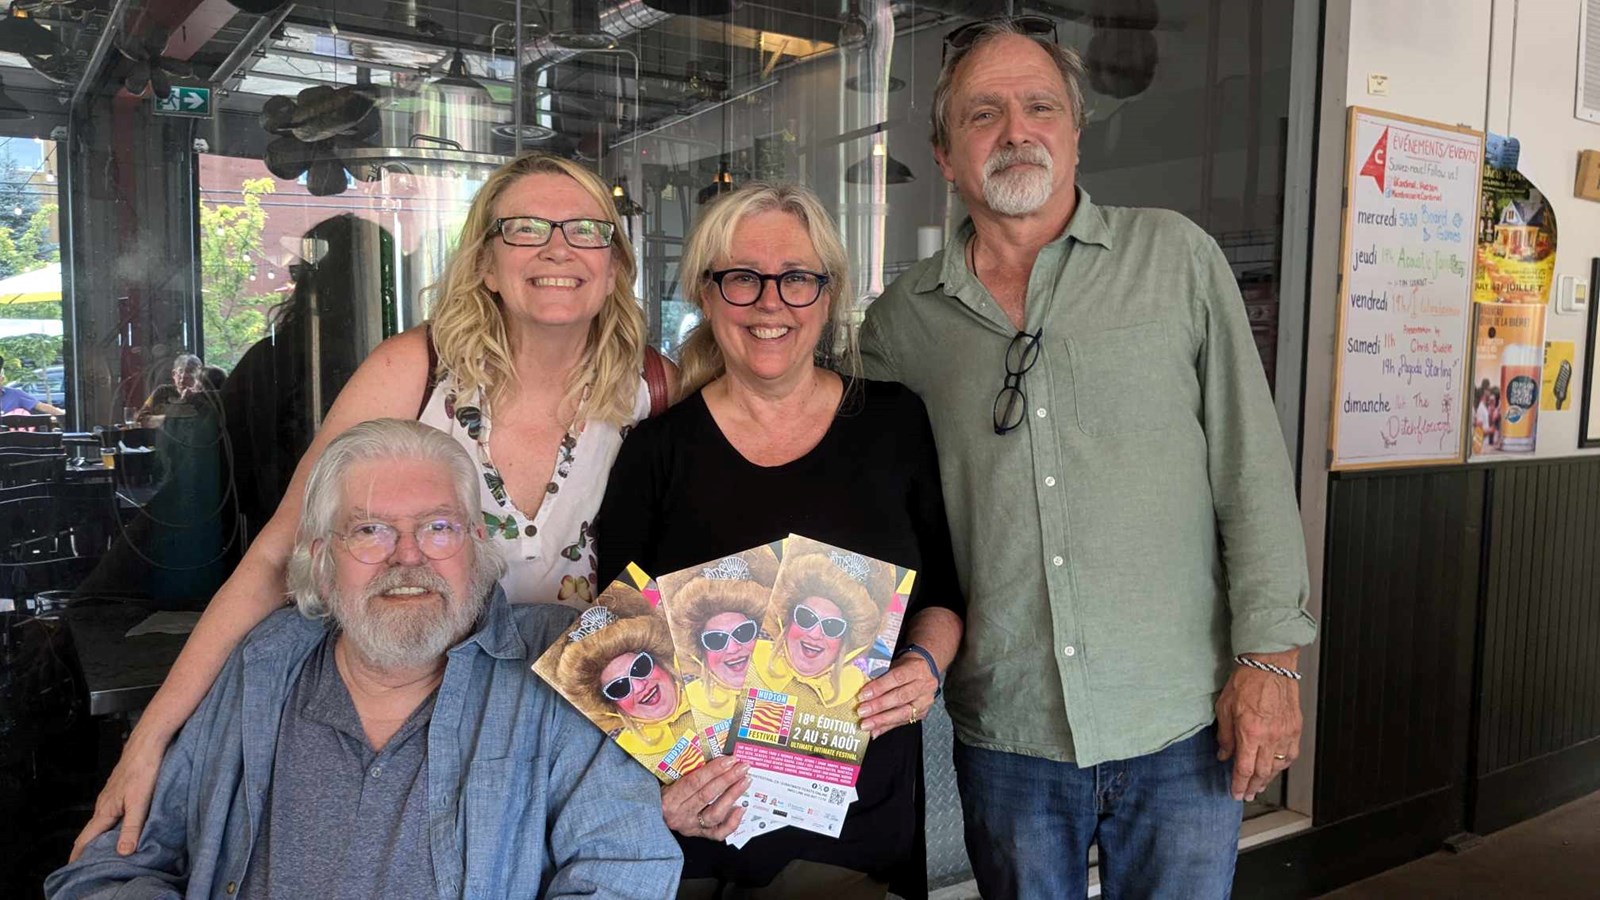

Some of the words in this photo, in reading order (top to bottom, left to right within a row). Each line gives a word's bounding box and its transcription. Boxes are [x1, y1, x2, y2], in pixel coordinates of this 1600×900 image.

[1375, 149, 1384, 164] C
[1358, 208, 1397, 227] mercredi
[1353, 244, 1377, 271] jeudi
[1350, 290, 1388, 311] vendredi
[1347, 335, 1381, 355] samedi
[1344, 393, 1391, 413] dimanche
[1413, 392, 1429, 408] The
[758, 690, 787, 702] HUDSON
[742, 699, 754, 727] MUSIQUE
[782, 710, 793, 732] MUSIC
[817, 715, 857, 735] ÉDITION
[749, 730, 777, 742] FESTIVAL
[792, 728, 802, 740] 2
[803, 731, 819, 744] AU
[821, 733, 829, 746] 5
[831, 735, 861, 752] AOÛT
[665, 738, 689, 764] HUDSON
[790, 741, 813, 752] ULTIMATE
[814, 745, 835, 756] INTIMATE
[836, 749, 858, 761] FESTIVAL
